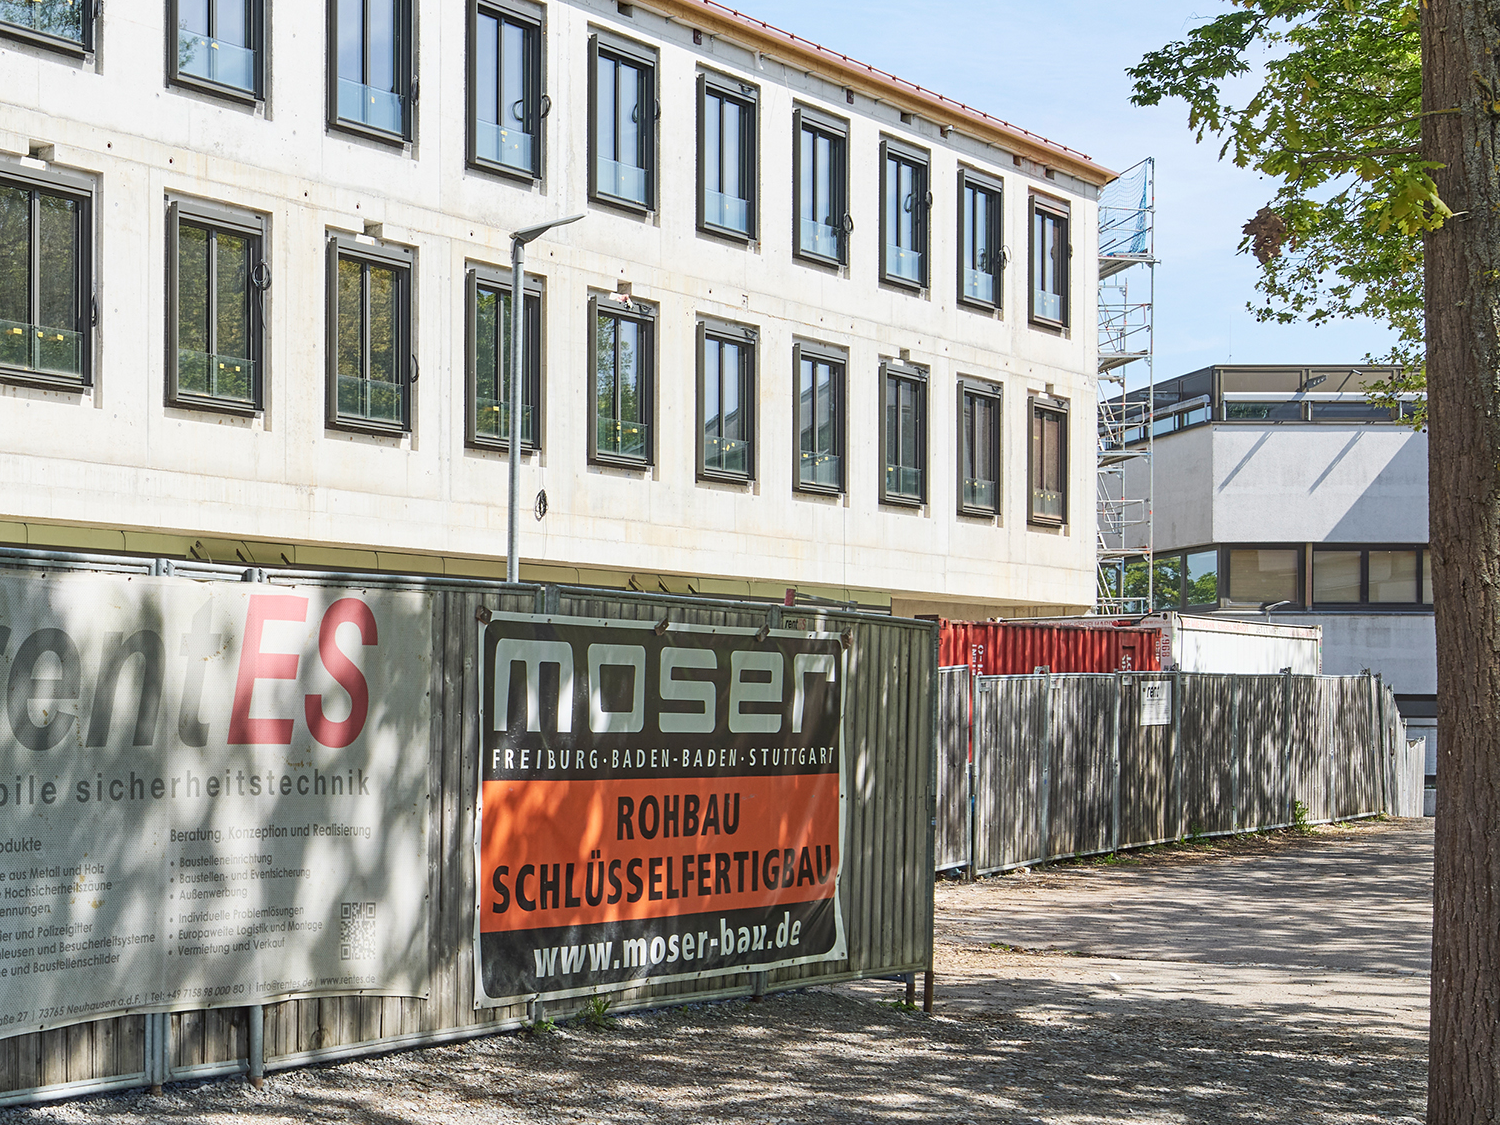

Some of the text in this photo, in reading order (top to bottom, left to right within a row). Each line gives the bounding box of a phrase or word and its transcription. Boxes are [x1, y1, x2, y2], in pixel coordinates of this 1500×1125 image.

[493, 637, 835, 734] moser
[76, 769, 370, 804] sicherheitstechnik
[617, 793, 740, 841] ROHBAU
[170, 823, 371, 844] Beratung, Konzeption und Realisierung
[179, 853, 273, 868] Baustelleneinrichtung
[9, 870, 27, 881] aus
[29, 865, 61, 880] Metall
[63, 864, 82, 876] und
[84, 863, 105, 875] Holz
[179, 867, 311, 884] Baustellen- und Eventsicherung
[492, 844, 832, 914] SCHLÜSSELFERTIGBAU
[4, 879, 113, 900] Hochsicherheitszäune
[179, 886, 248, 901] Außenwerbung
[179, 905, 305, 924] Individuelle Problemlösungen
[15, 926, 35, 940] und
[37, 922, 93, 939] Polizeigitter
[178, 920, 323, 941] Europaweite Logistik und Montage
[37, 943, 57, 956] und
[59, 933, 156, 953] Besucherleitsysteme
[178, 937, 285, 956] Vermietung und Verkauf
[534, 911, 802, 978] www.moser-bau.de
[10, 960, 30, 976] und
[32, 952, 121, 973] Baustellenschilder
[16, 1011, 29, 1023] 27
[39, 1007, 64, 1019] 73765
[66, 999, 115, 1015] Neuhausen
[166, 988, 181, 999] +49
[204, 987, 213, 997] 98
[214, 986, 231, 996] 000
[233, 984, 244, 994] 80
[320, 975, 376, 986] www.rentes.de
